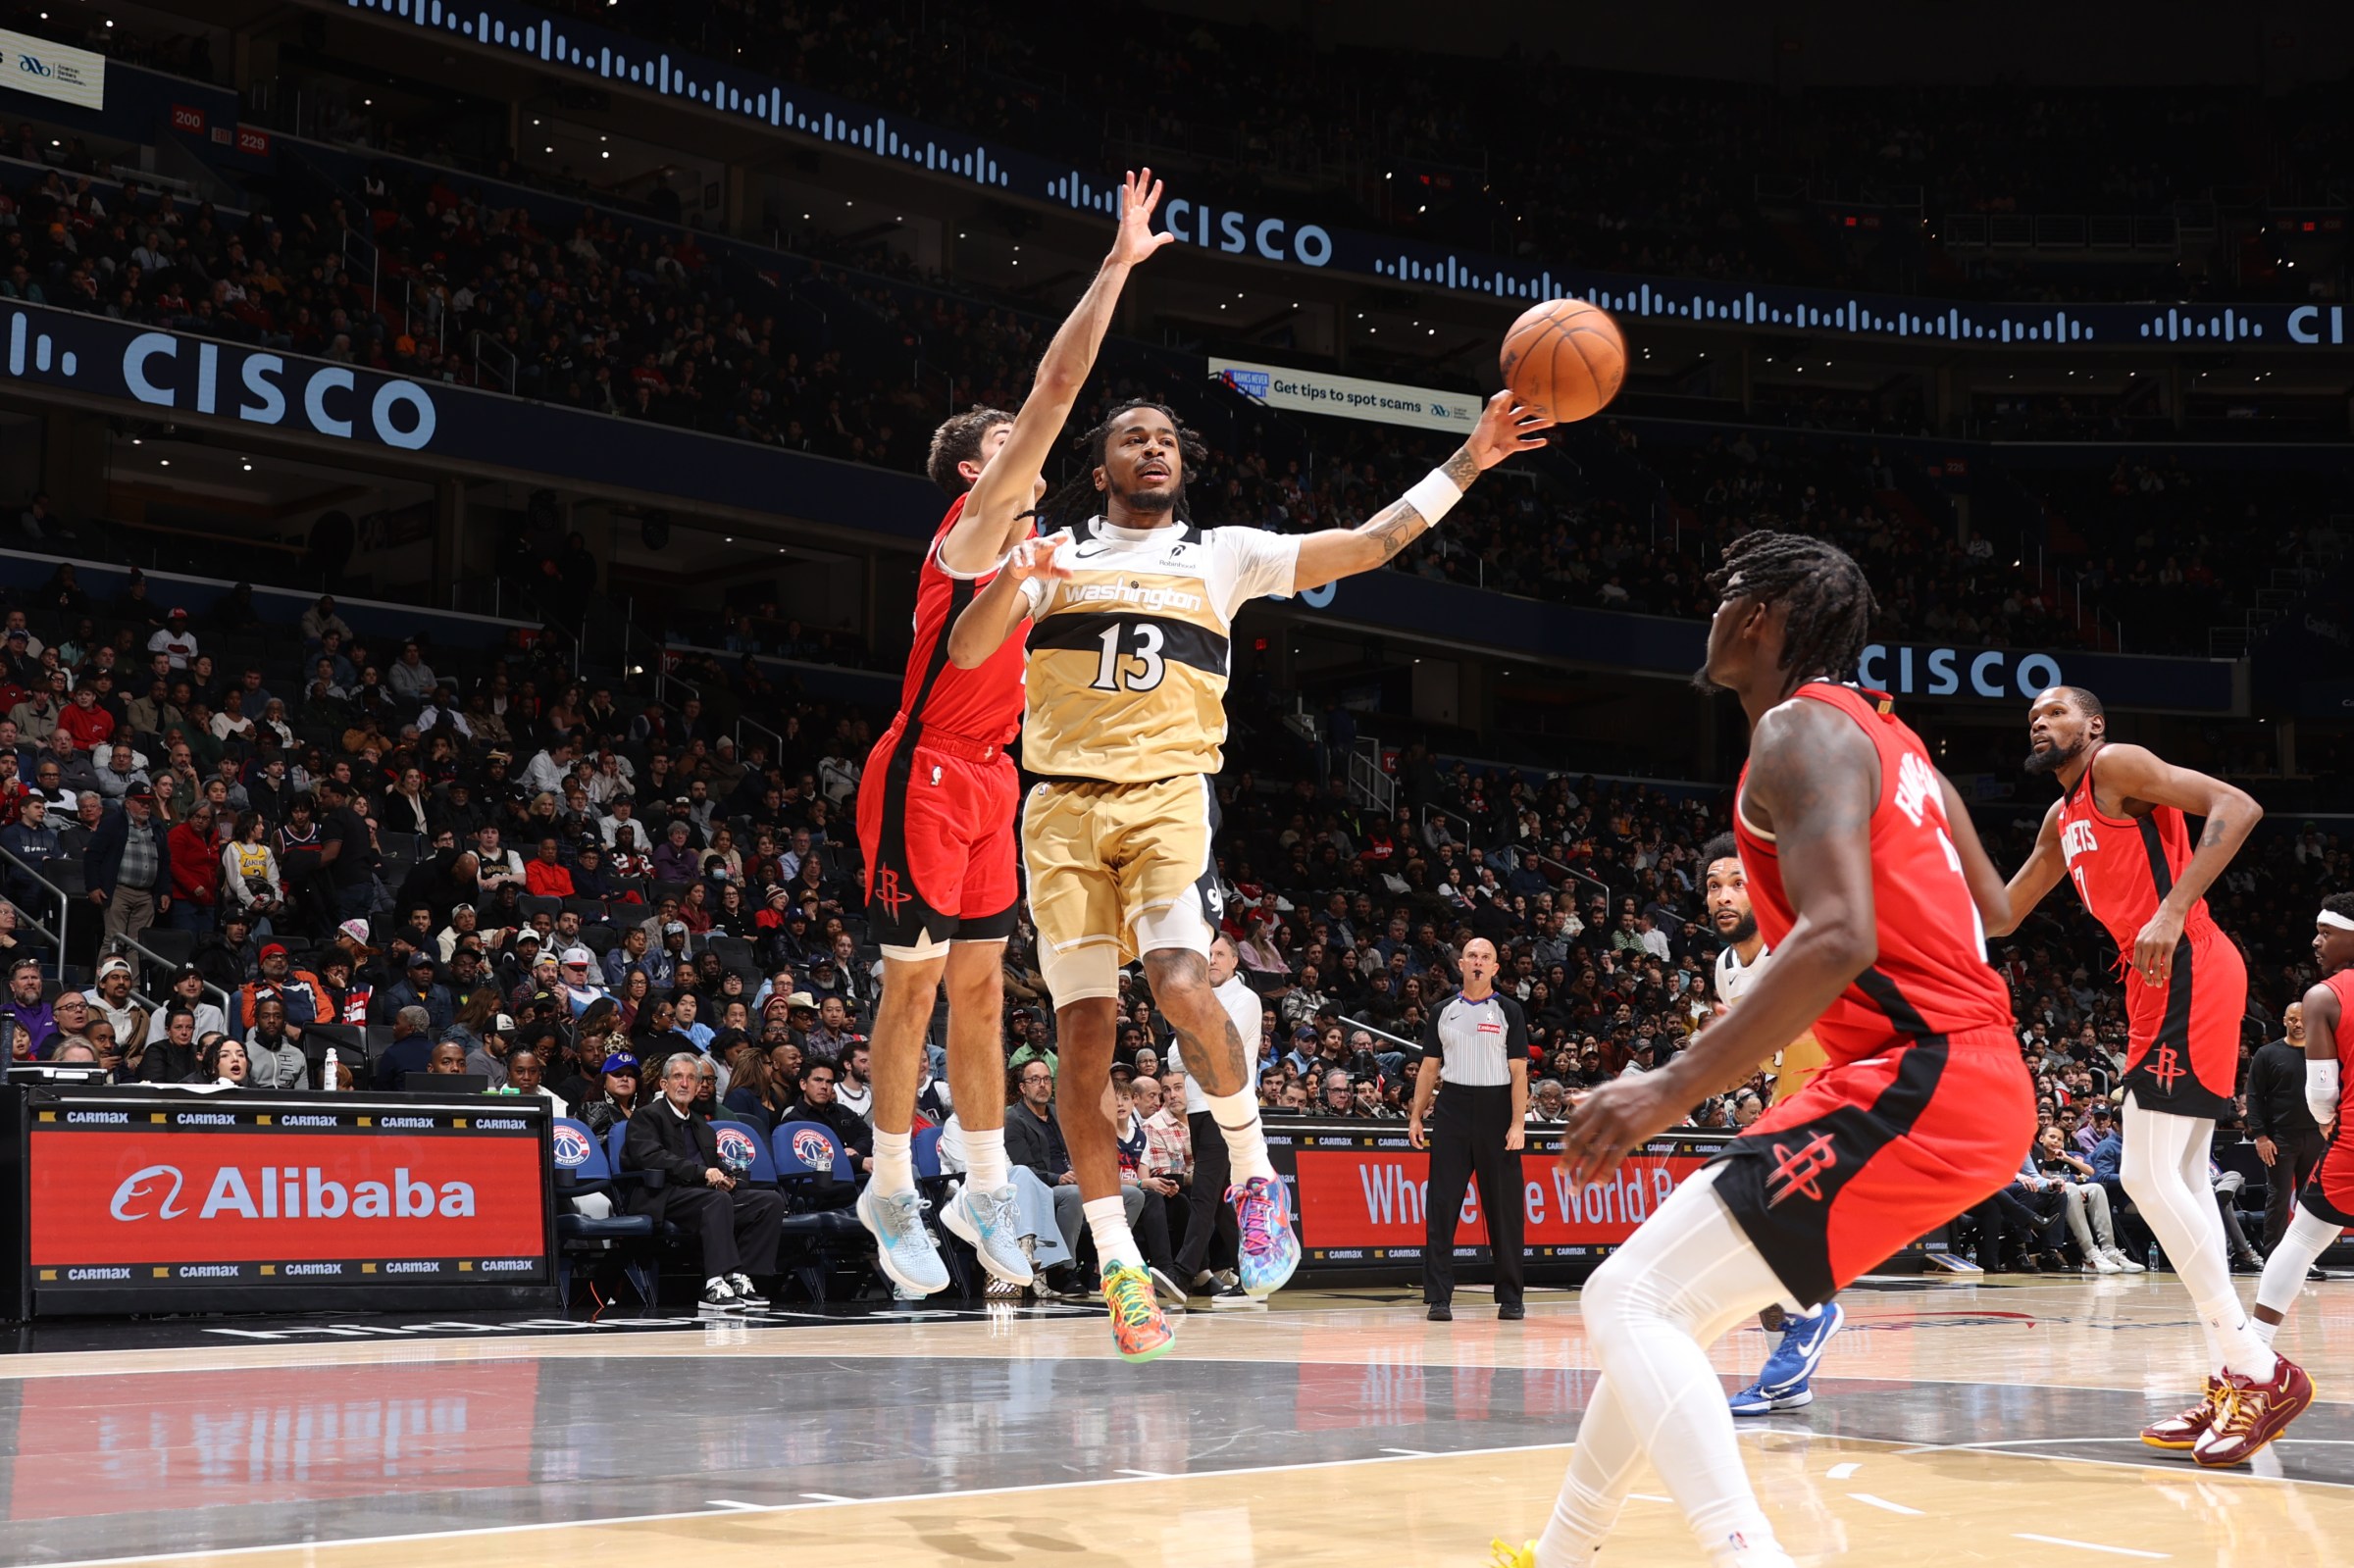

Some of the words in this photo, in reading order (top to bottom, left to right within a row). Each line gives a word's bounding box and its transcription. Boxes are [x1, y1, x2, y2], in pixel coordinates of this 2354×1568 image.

[175, 110, 201, 128] 200
[240, 133, 266, 151] 229
[1165, 198, 1333, 267] CISCO
[122, 331, 436, 451] CISCO
[1234, 372, 1251, 383] BANKS
[1252, 374, 1268, 384] NEVER
[1274, 379, 1299, 394] Get
[1302, 383, 1326, 400] tips
[1329, 386, 1344, 401] to
[1347, 389, 1376, 407] spot
[1380, 397, 1421, 413] scams
[1158, 559, 1197, 570] Robinhood
[1064, 576, 1203, 612] washington
[1088, 622, 1166, 692] 13
[1858, 643, 2063, 699] CISCO
[2073, 865, 2093, 903] 7
[199, 1166, 476, 1219] Alibaba
[1552, 1167, 1647, 1225] World
